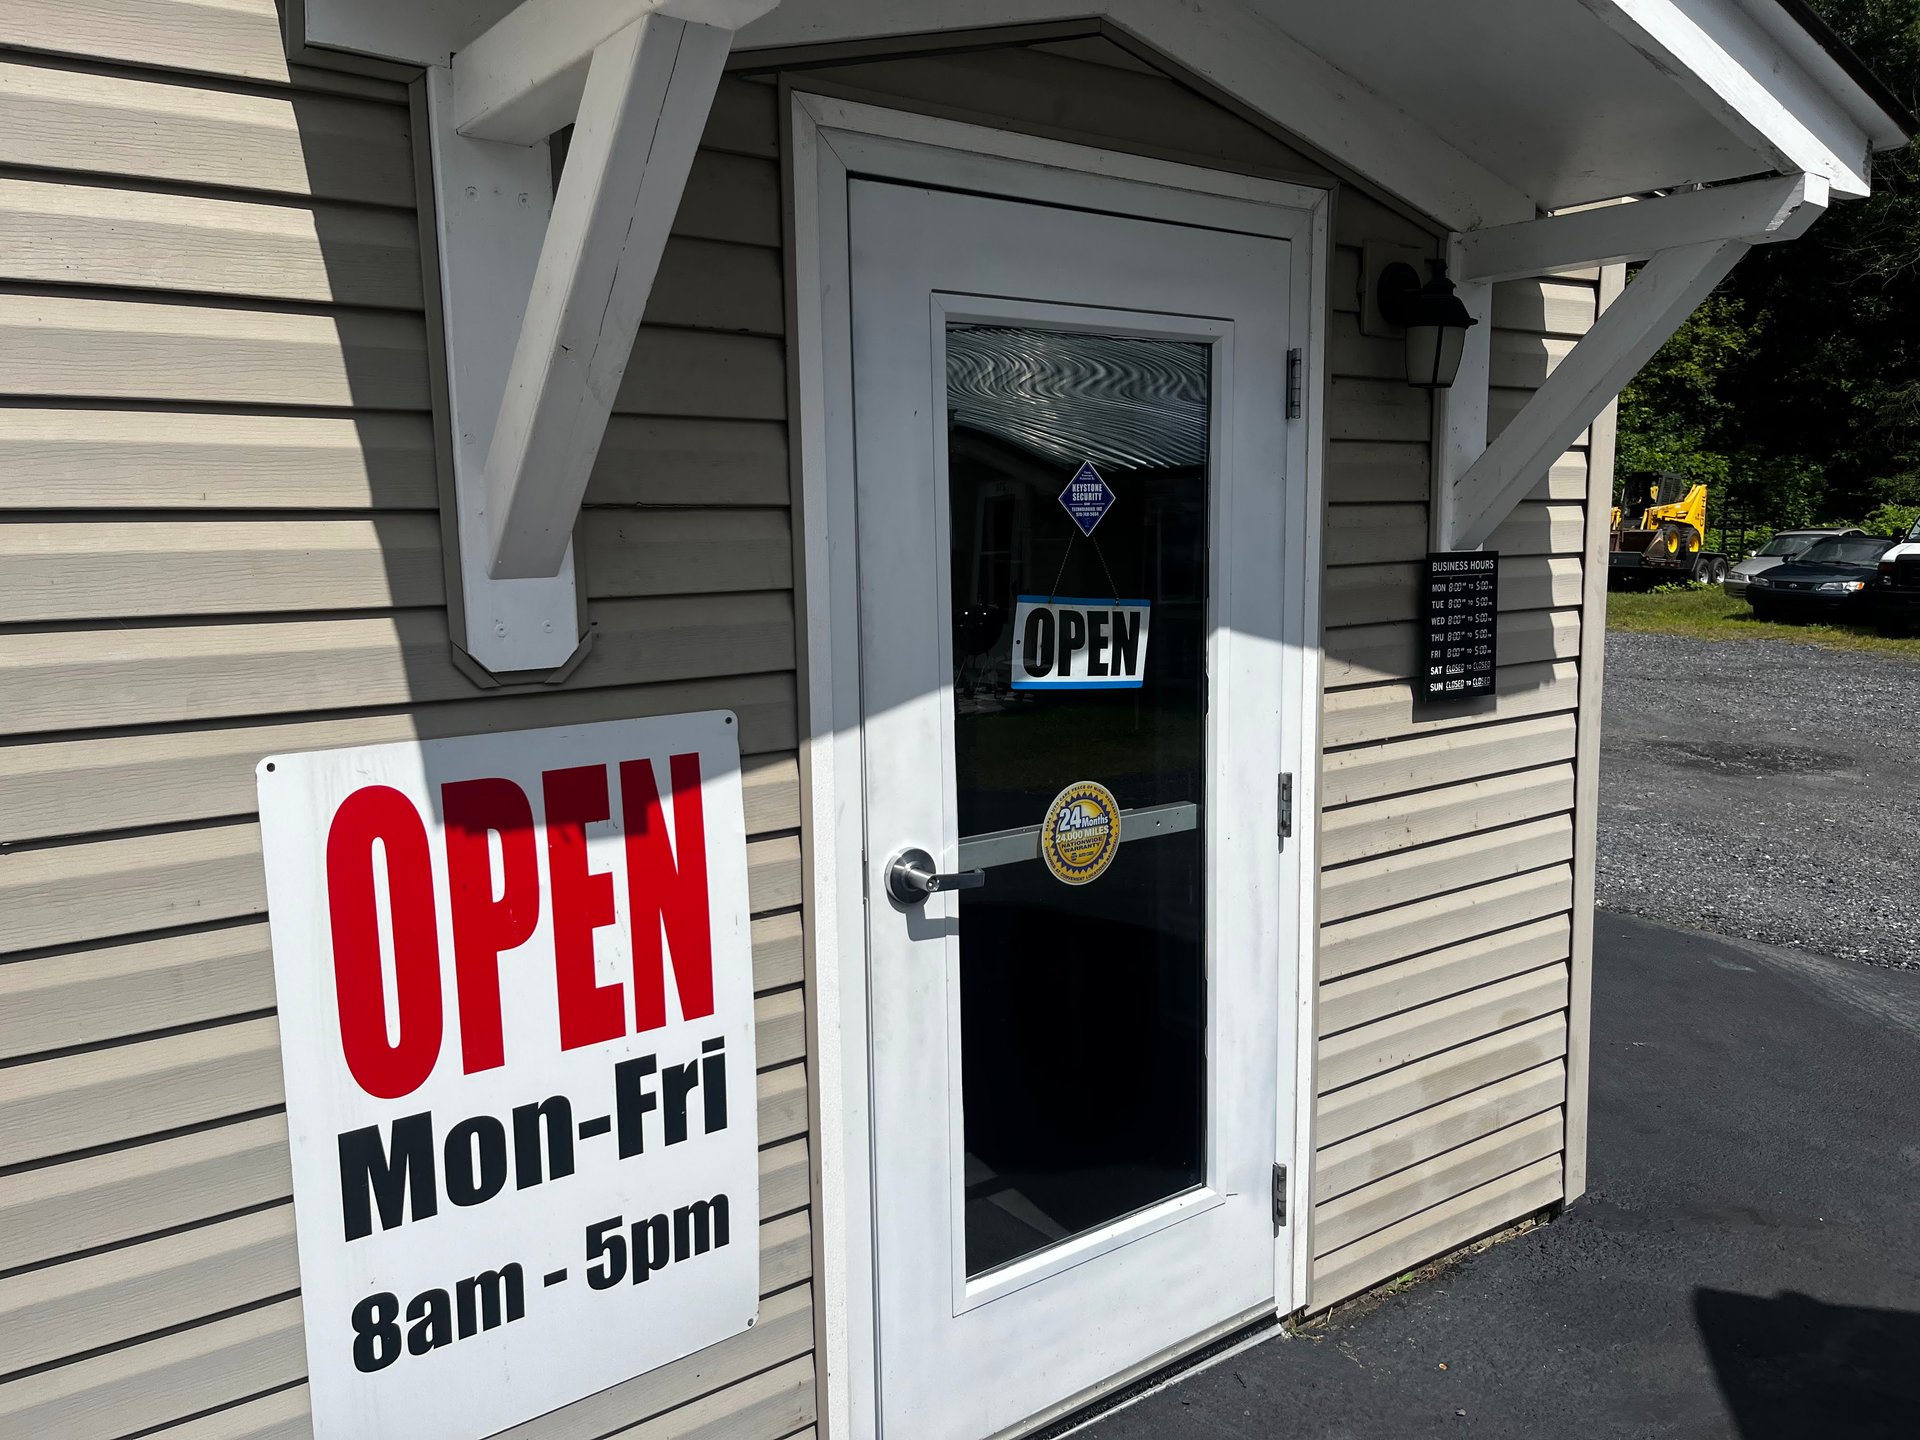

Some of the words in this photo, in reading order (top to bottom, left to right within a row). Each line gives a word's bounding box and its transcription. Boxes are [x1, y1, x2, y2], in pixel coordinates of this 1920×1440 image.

[1072, 484, 1102, 492] KEYSTONE
[1072, 493, 1102, 501] SECURITY
[1432, 561, 1468, 571] BUSINESS
[1470, 560, 1494, 570] HOURS
[1432, 584, 1446, 592] MON
[1432, 601, 1444, 609] TUE
[1431, 617, 1445, 625] WED
[1022, 608, 1141, 678] OPEN
[1431, 634, 1444, 642] THU
[1431, 650, 1440, 658] FRI
[1430, 666, 1442, 675] SAT
[1446, 664, 1465, 673] CLOSED
[1473, 661, 1491, 669] CLOSED
[1430, 682, 1443, 691] SUN
[1446, 680, 1464, 689] CLOSED
[1473, 677, 1490, 686] CLOSED
[1051, 802, 1060, 815] AUTO
[1060, 791, 1070, 801] CARE
[1105, 795, 1118, 819] WARRANTY
[1060, 806, 1081, 831] 24
[1082, 814, 1108, 828] Months
[1056, 831, 1083, 844] 24,000
[1085, 825, 1109, 837] MILES
[1062, 836, 1102, 848] NATIONWIDE
[1064, 842, 1100, 853] WARRANTY
[1060, 873, 1085, 881] CONVENIENT
[1086, 862, 1106, 880] LOCATIONS
[326, 752, 714, 1099] OPEN
[337, 1036, 729, 1242] Mon-Fri
[351, 1260, 526, 1373] 8am
[543, 1268, 567, 1288] -
[585, 1192, 730, 1291] 5pm
